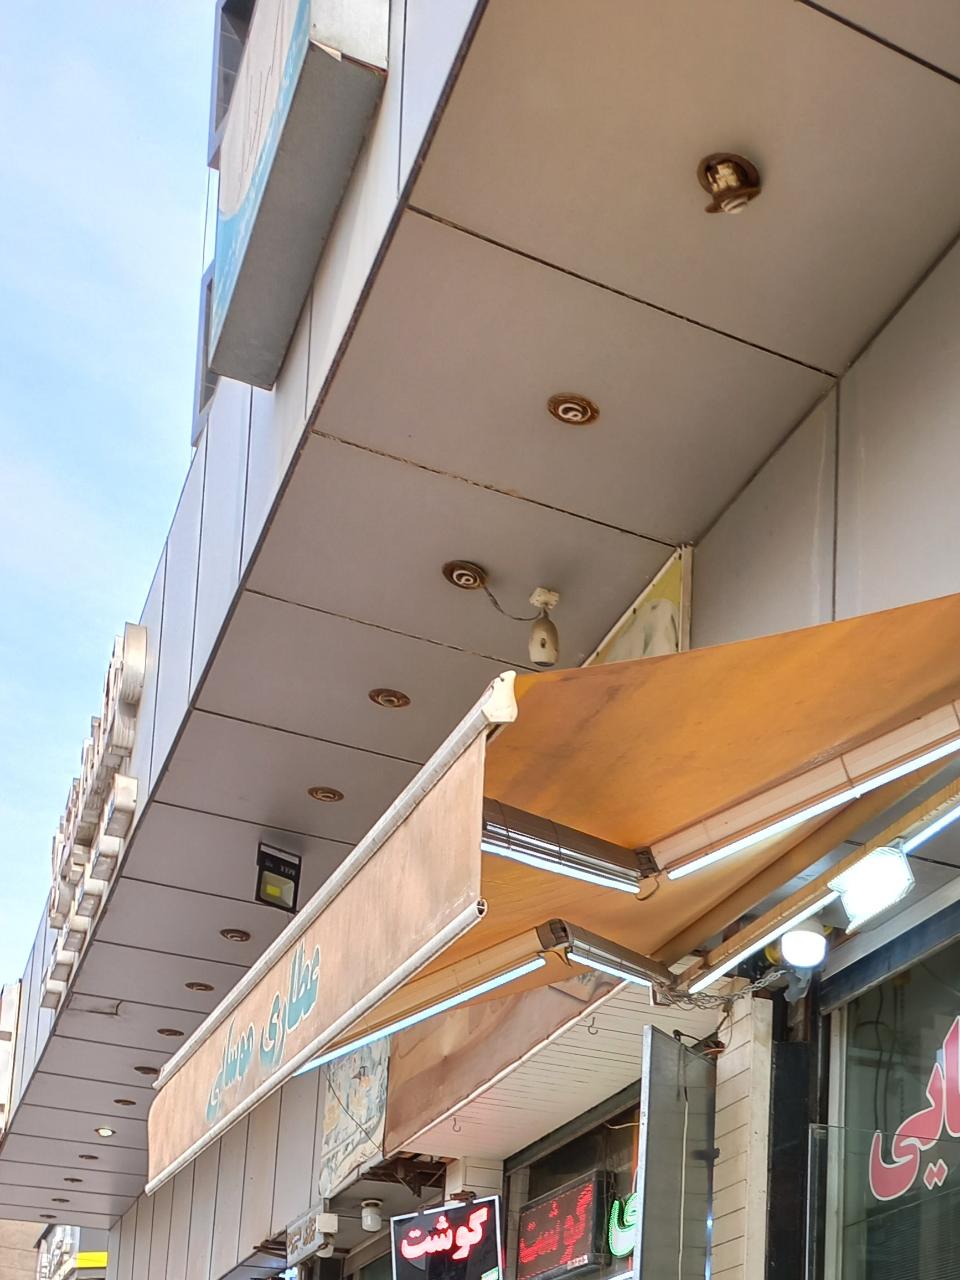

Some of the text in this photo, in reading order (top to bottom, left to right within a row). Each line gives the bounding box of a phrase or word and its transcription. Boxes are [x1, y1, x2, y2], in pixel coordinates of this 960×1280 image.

[260, 937, 321, 1071] عطاری
[401, 1206, 489, 1261] گوشت
[519, 1184, 594, 1265] گوشت
